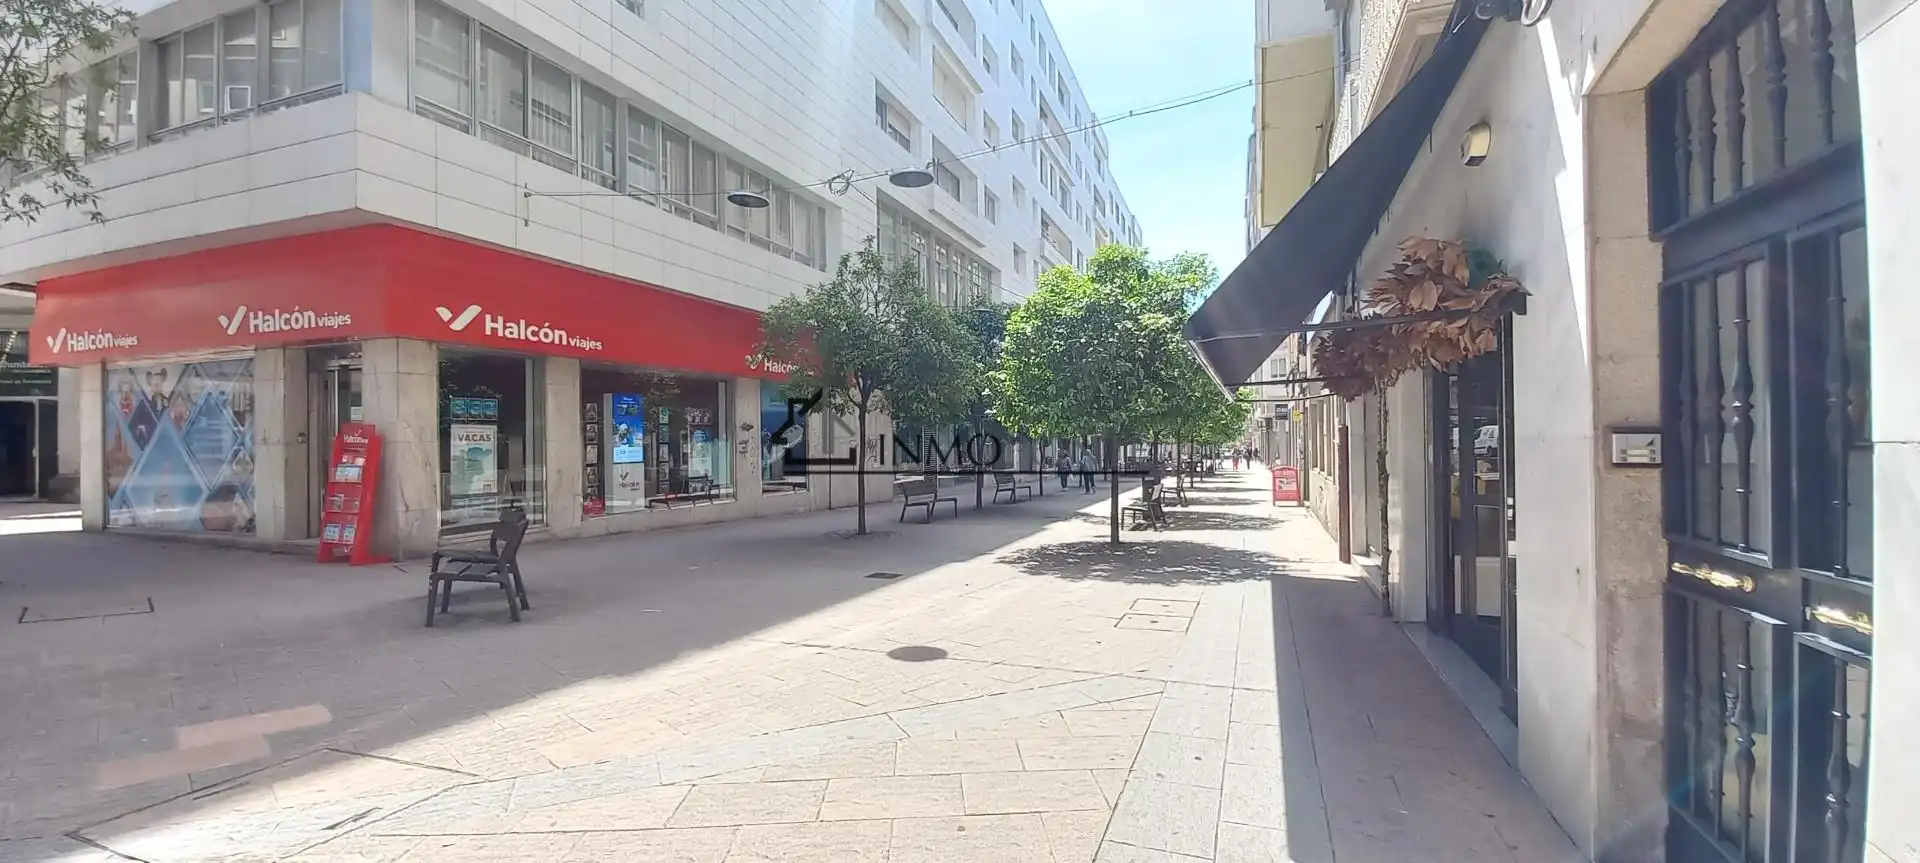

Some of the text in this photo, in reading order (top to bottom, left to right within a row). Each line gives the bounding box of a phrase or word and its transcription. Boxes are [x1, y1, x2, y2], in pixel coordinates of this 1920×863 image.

[248, 306, 352, 333] Halcón viajes
[67, 328, 139, 352] Halcón viajes
[484, 314, 602, 351] Halcón viajes
[457, 433, 492, 442] VACAS
